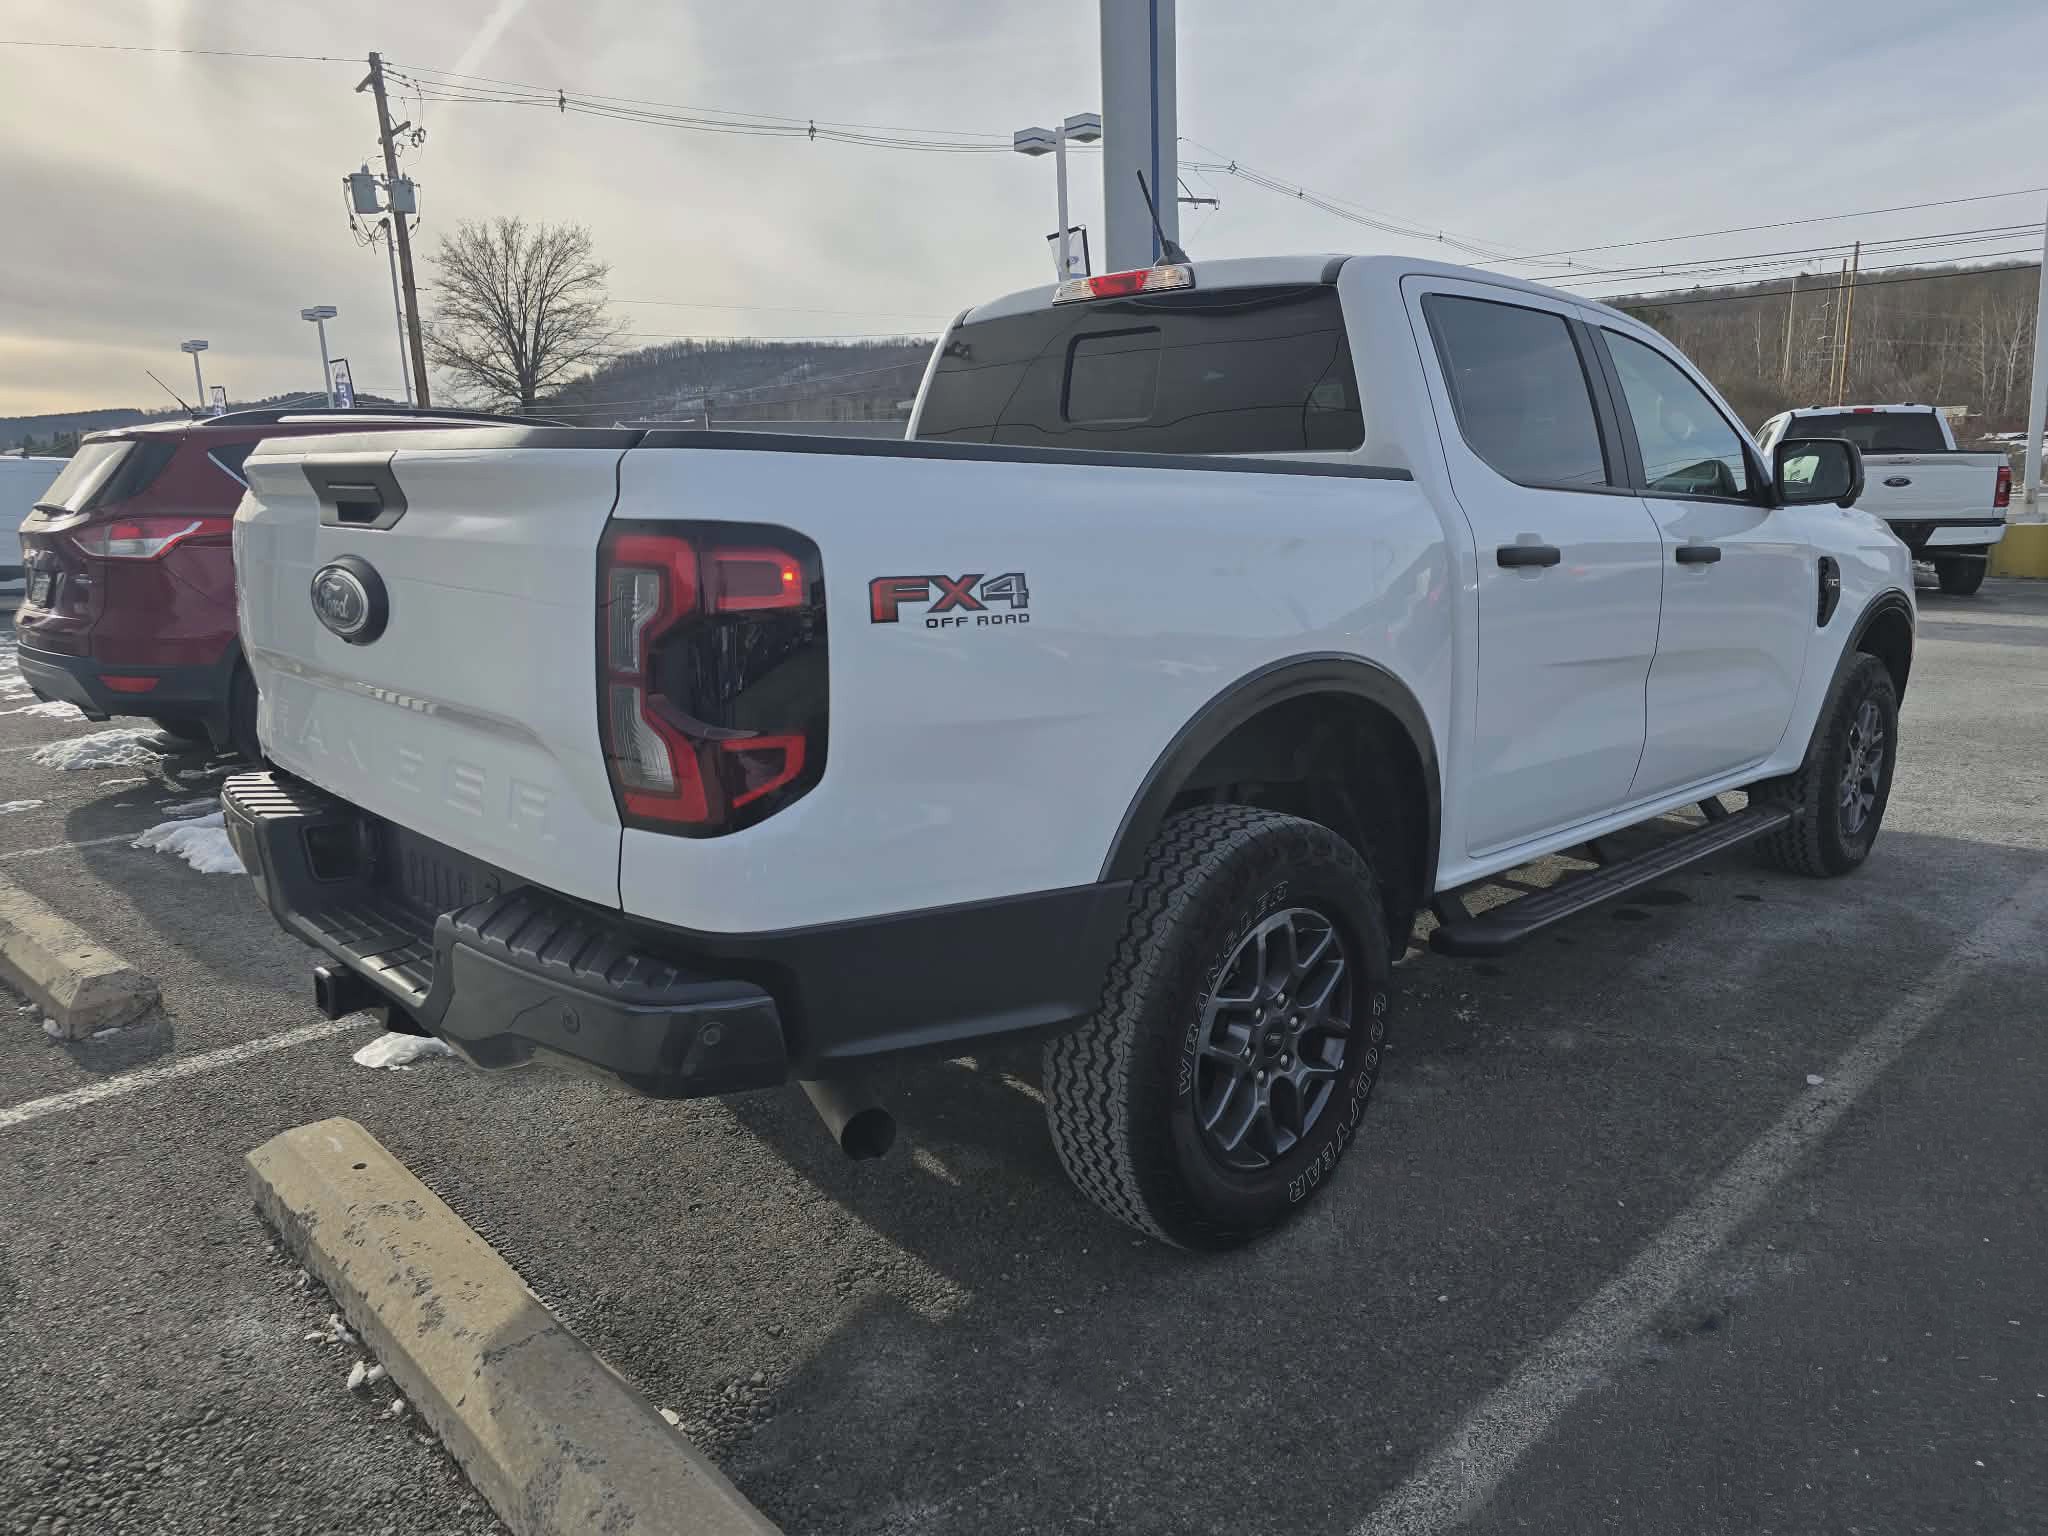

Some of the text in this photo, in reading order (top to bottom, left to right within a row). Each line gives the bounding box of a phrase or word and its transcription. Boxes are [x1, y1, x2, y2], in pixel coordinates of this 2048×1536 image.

[319, 578, 350, 618] Ford
[868, 573, 1029, 624] FX4
[926, 614, 1030, 629] OFF ROAD
[1288, 993, 1387, 1203] GOODYEAR
